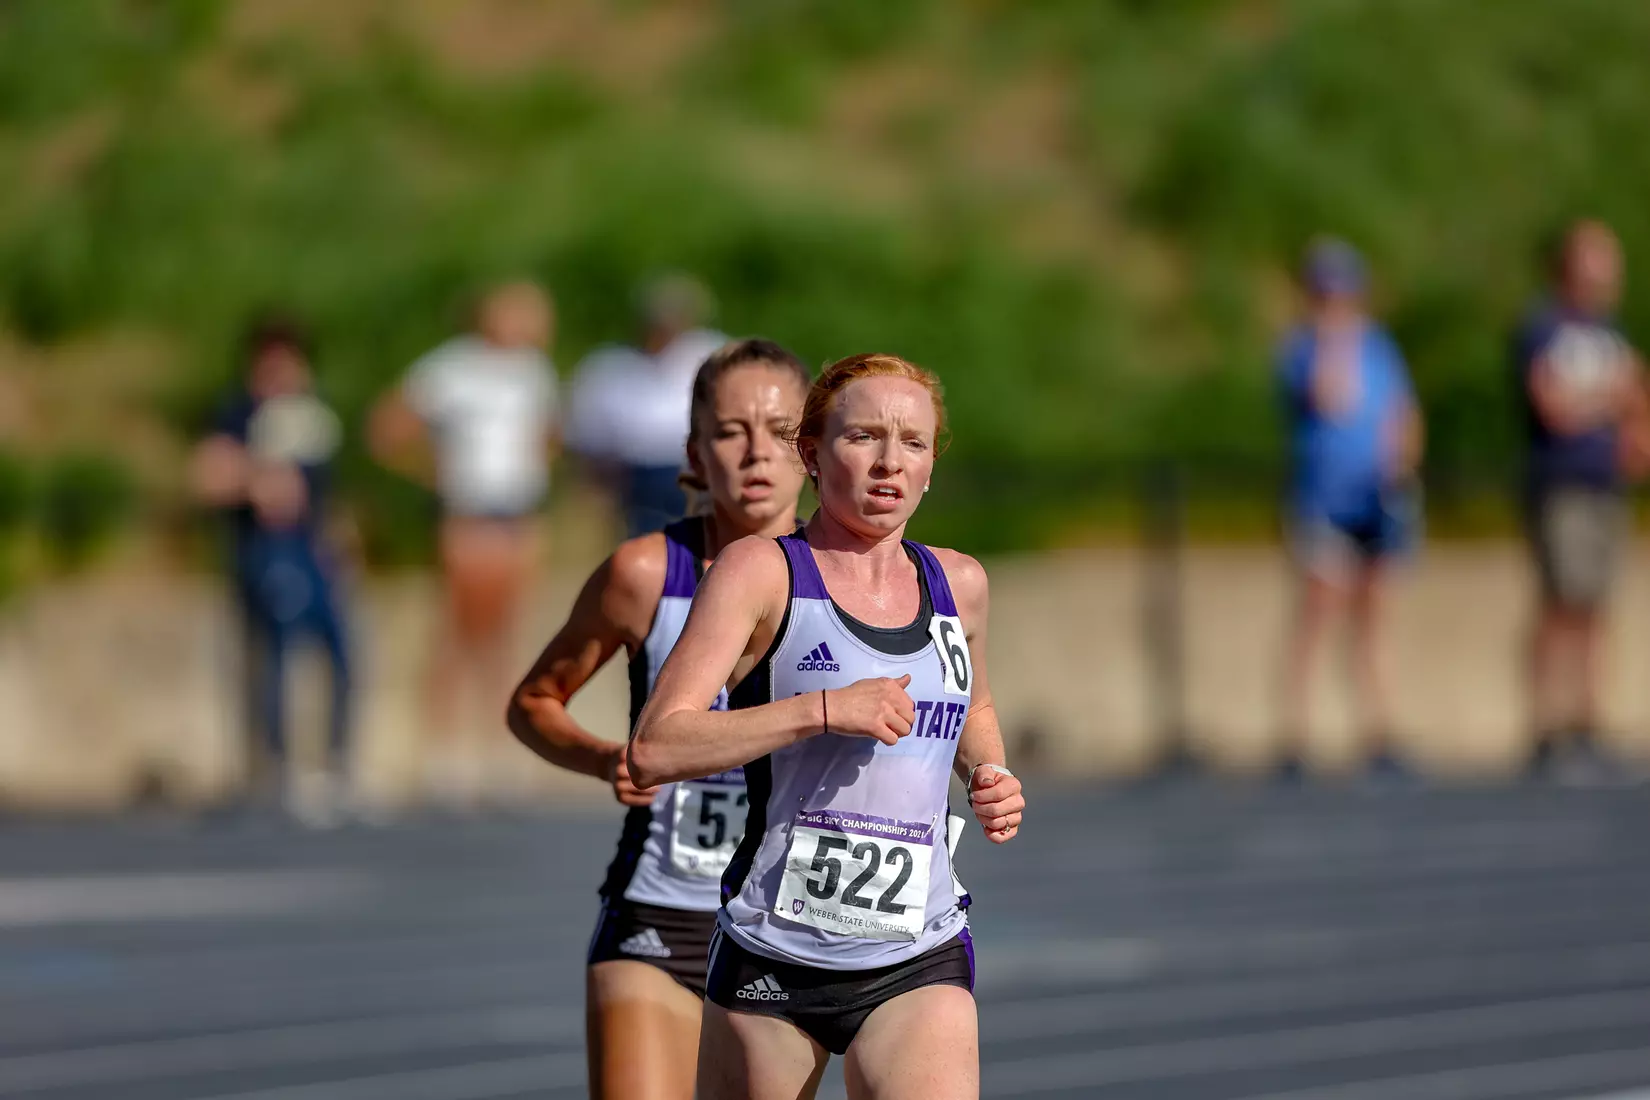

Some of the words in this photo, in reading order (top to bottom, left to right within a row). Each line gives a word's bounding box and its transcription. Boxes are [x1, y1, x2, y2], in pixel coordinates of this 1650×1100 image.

[797, 660, 840, 672] adidas
[940, 620, 968, 691] 6
[913, 700, 965, 740] TATE
[807, 815, 822, 823] BIG
[824, 816, 840, 826] SKY
[842, 818, 907, 836] CHAMPIONSHIPS
[909, 829, 925, 839] 2021
[806, 835, 913, 915] 522
[809, 906, 837, 921] WEBER
[839, 915, 863, 927] STATE
[865, 920, 910, 934] UNIVERSITY
[736, 989, 790, 1001] adidas
